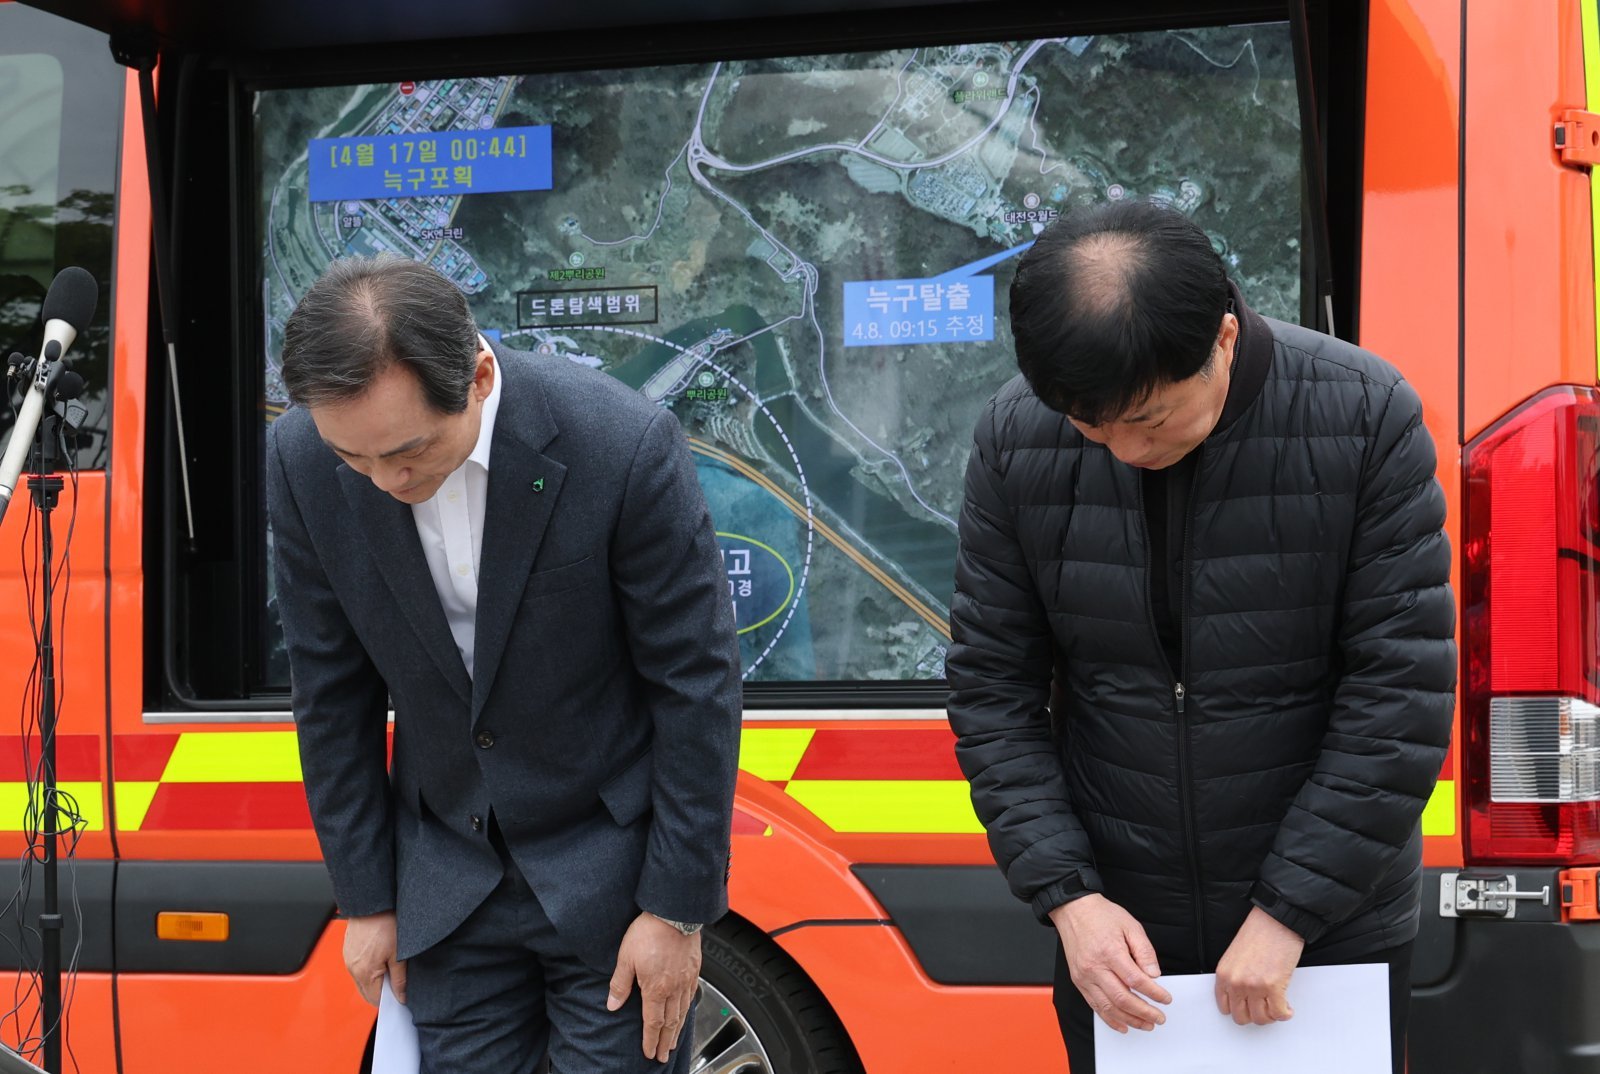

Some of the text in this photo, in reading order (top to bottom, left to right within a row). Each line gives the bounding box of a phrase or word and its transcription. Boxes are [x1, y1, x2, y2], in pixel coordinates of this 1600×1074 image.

[330, 135, 526, 168] [4월 17일 00:44]
[383, 166, 473, 191] 늑구포획
[1004, 210, 1058, 223] 대전오월드
[420, 228, 463, 240] SK엔크린
[549, 267, 606, 281] 제2뿌리공원
[531, 294, 640, 316] 드론탐색범위
[866, 282, 971, 314] 늑구탈출
[851, 314, 984, 340] 4.8. 09:15 추정
[686, 388, 728, 401] 뿌리공원
[720, 549, 751, 575] 고
[703, 939, 757, 988] UMHO
